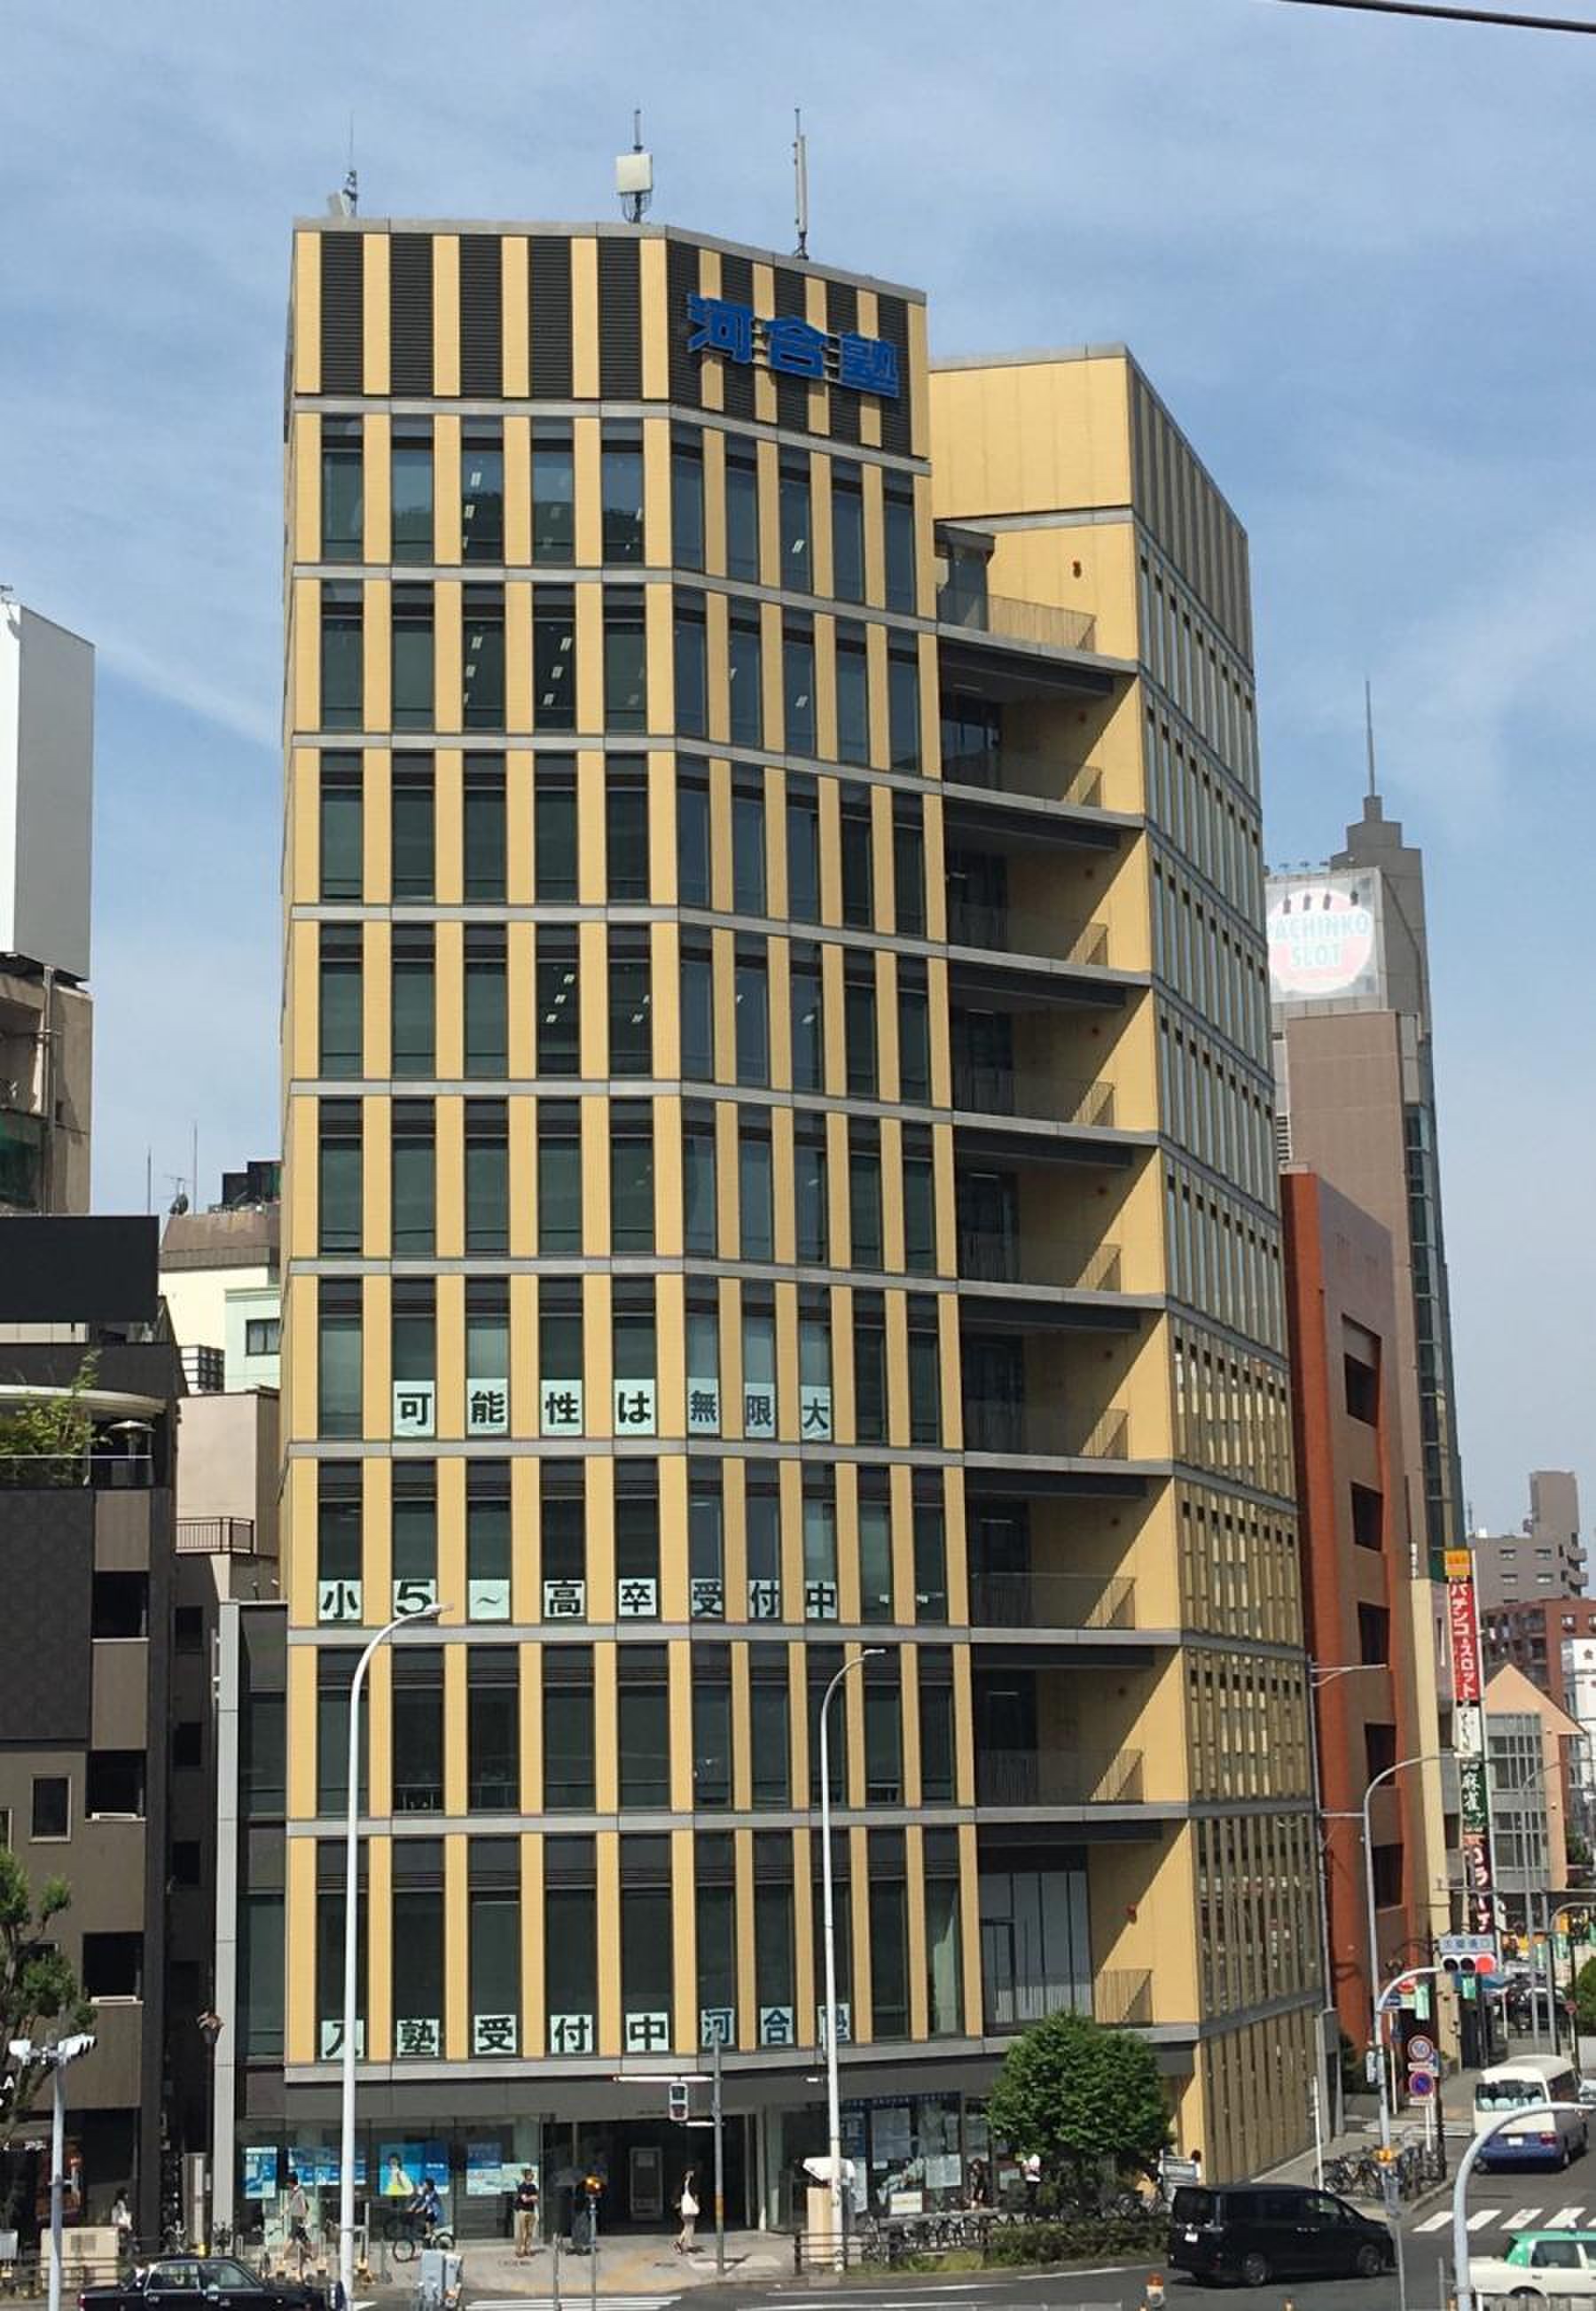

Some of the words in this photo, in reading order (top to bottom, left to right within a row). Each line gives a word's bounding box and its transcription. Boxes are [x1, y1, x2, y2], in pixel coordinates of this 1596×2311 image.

[687, 293, 899, 398] 河合塾
[397, 1390, 829, 1430] 可能性は無限大
